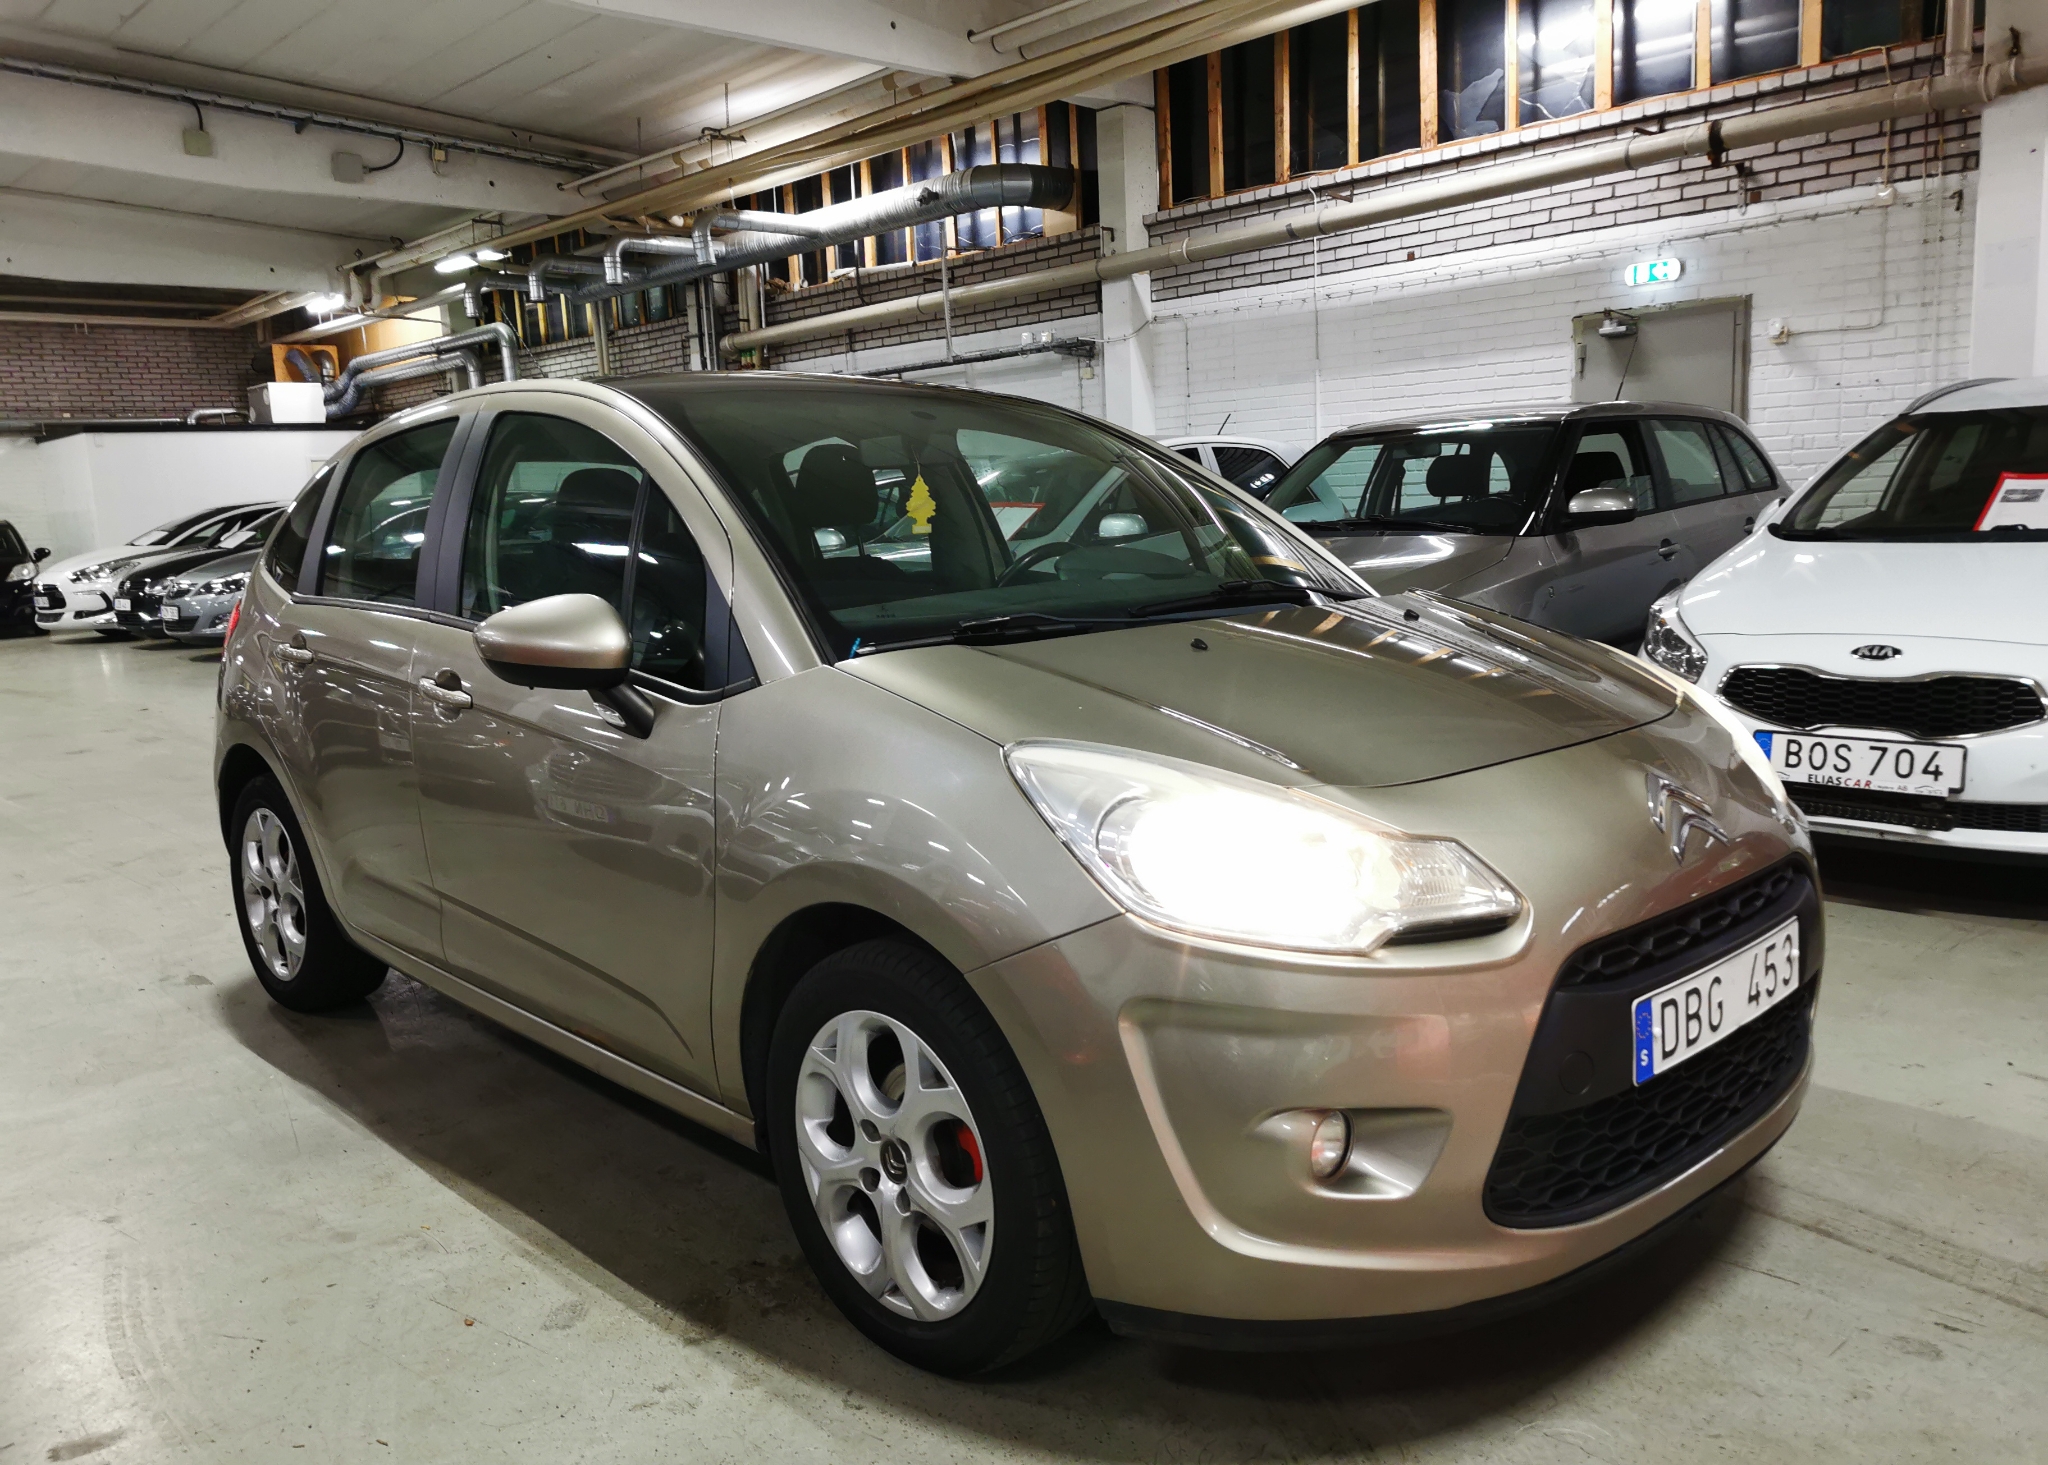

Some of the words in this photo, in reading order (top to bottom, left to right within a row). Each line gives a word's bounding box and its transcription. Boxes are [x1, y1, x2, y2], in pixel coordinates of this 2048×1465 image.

[1857, 645, 1894, 657] KIA
[1785, 739, 1852, 773] BOS
[1868, 745, 1944, 782] 704
[1640, 1049, 1649, 1066] S
[1661, 976, 1723, 1060] DBG
[1747, 933, 1793, 1007] 453
